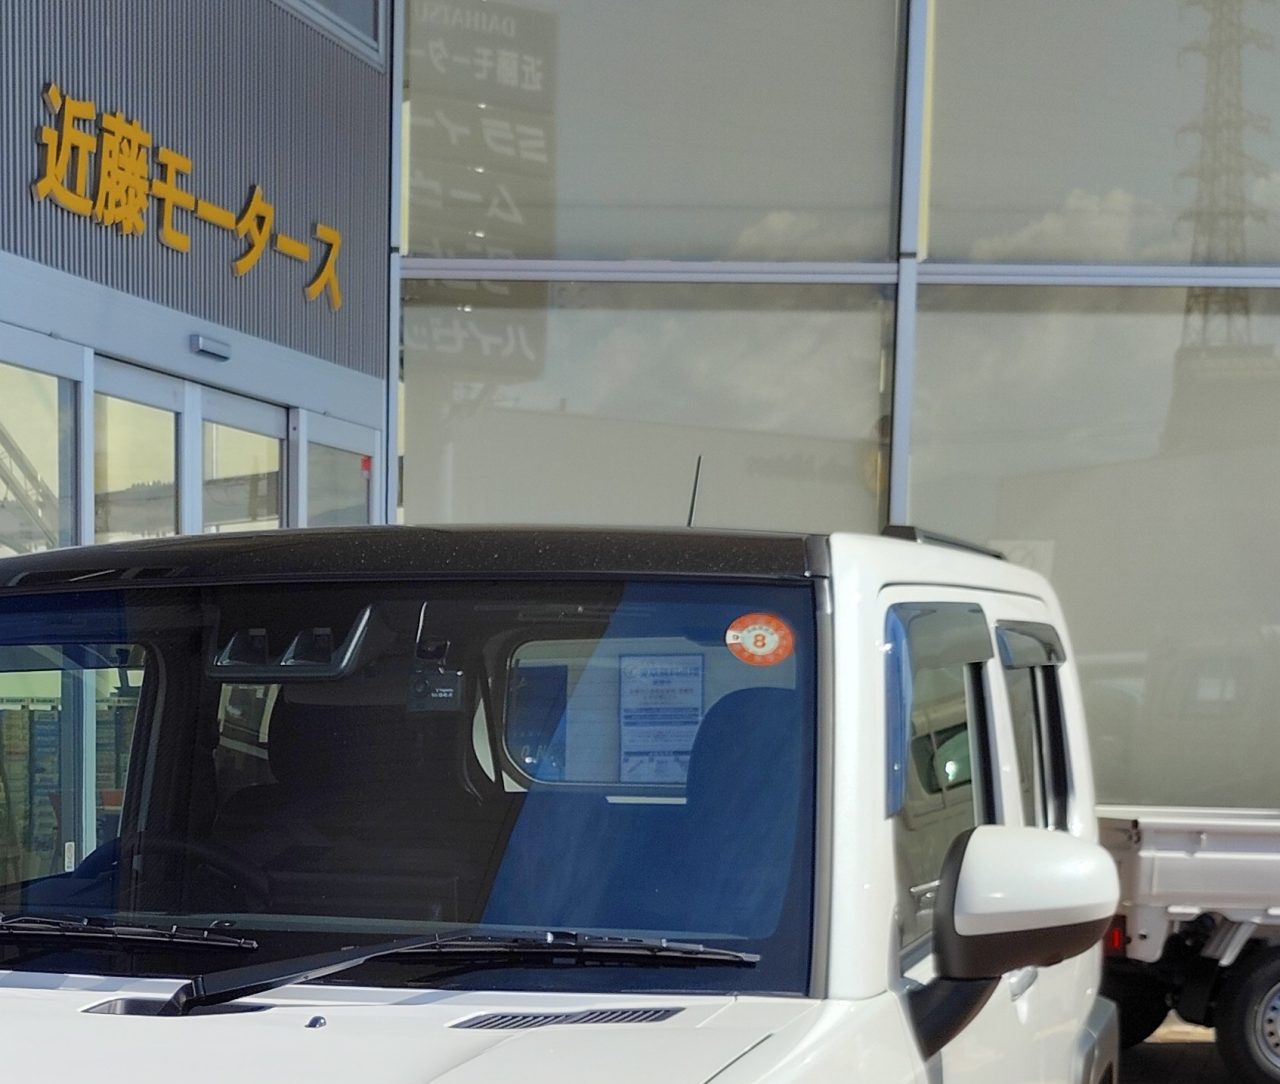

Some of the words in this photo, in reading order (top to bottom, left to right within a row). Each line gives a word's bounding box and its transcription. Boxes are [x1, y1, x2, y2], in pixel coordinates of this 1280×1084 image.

[31, 80, 343, 312] 近藤モータース
[753, 633, 767, 648] 8
